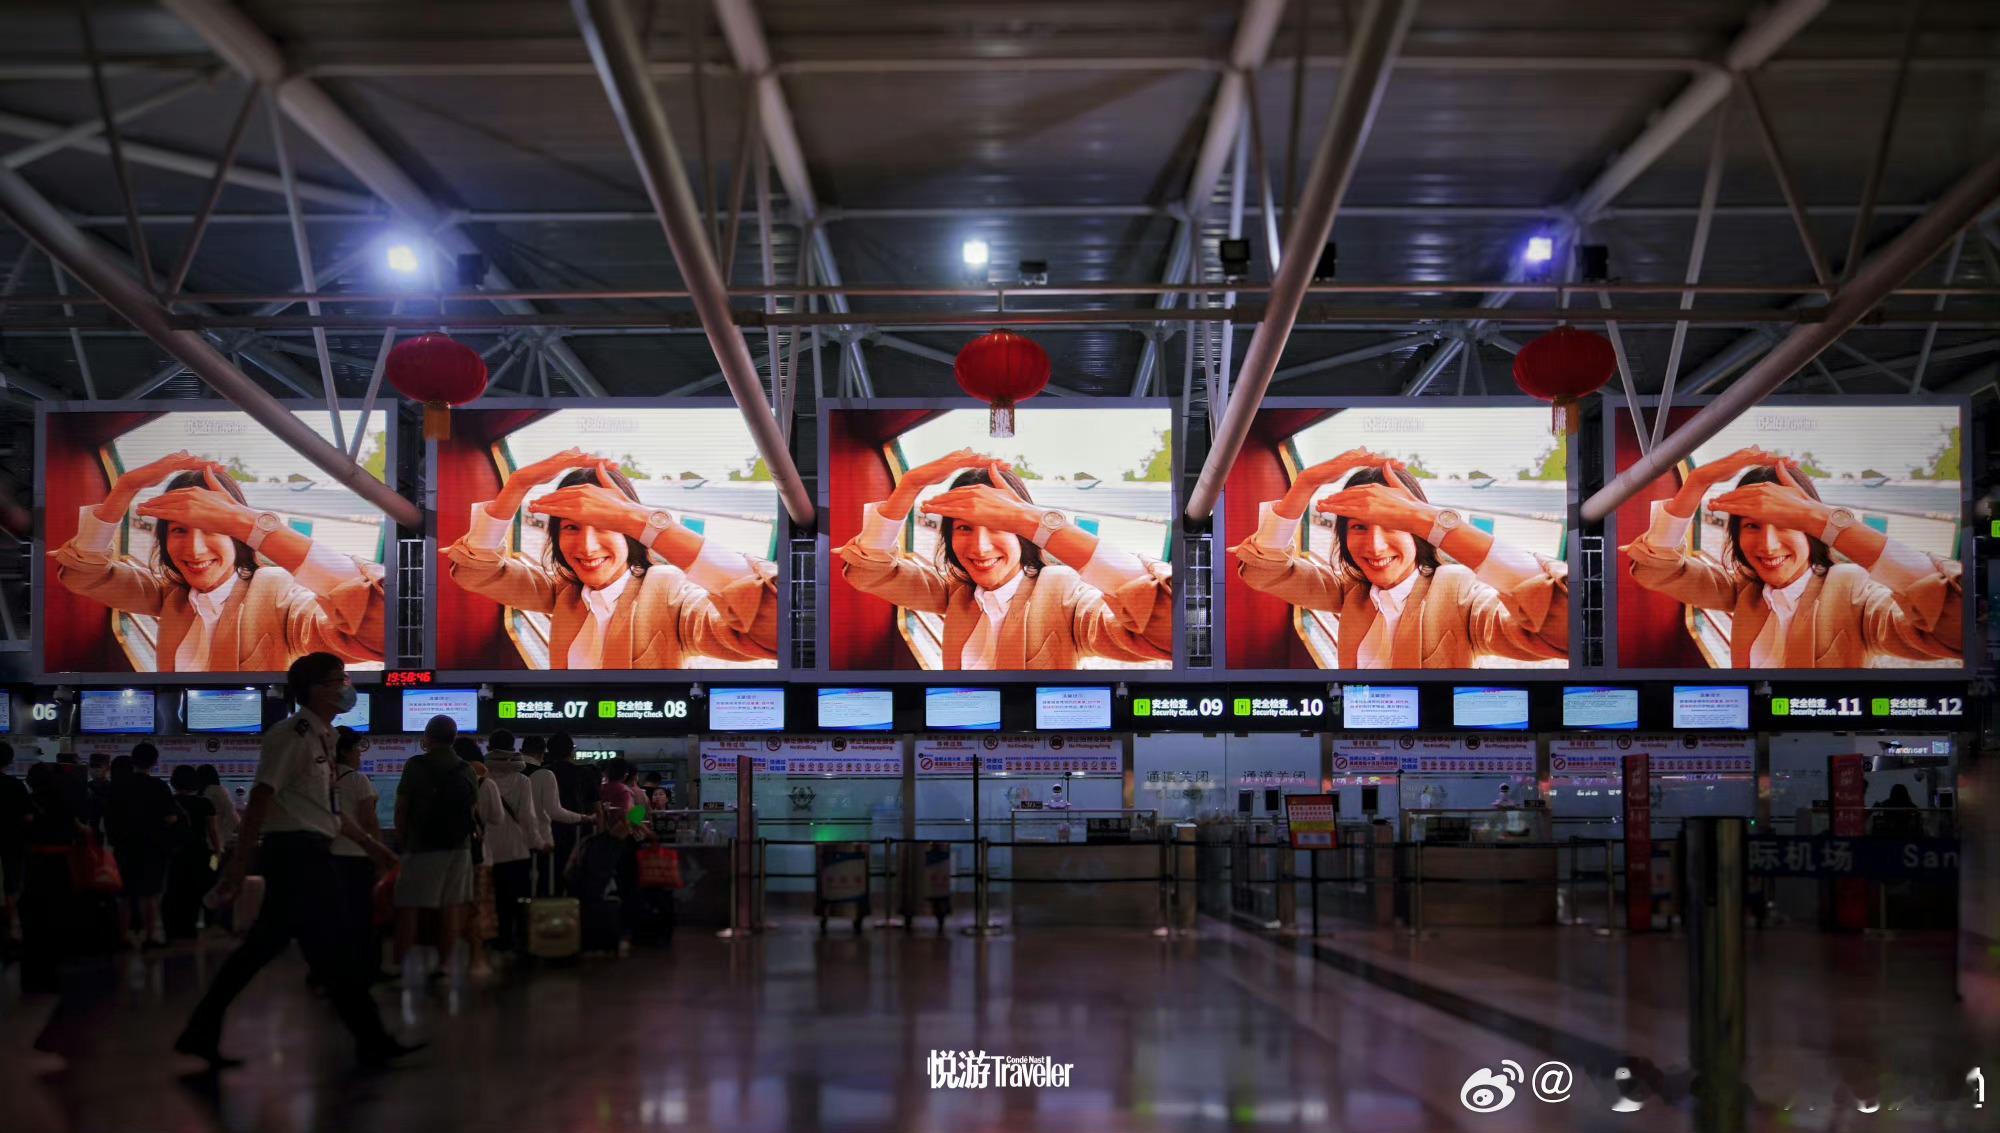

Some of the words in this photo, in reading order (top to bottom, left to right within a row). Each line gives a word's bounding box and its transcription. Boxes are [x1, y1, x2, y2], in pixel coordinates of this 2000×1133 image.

[517, 701, 553, 711] 安全检查
[617, 700, 653, 710] 安全检查
[1152, 699, 1188, 709] 安全检查
[1200, 698, 1223, 716] 09
[1252, 699, 1288, 709] 安全检查
[1300, 699, 1324, 716] 10
[1790, 698, 1826, 708] 安全检查
[1838, 698, 1862, 715] 11
[1890, 698, 1926, 708] 安全检查
[1938, 698, 1963, 715] 12
[32, 703, 57, 720] 06
[564, 701, 588, 718] 07
[617, 710, 642, 718] Security
[664, 700, 688, 718] 08
[1152, 709, 1177, 717] Security
[1252, 709, 1277, 717] Security
[1790, 708, 1815, 716] Security
[1890, 708, 1915, 716] Security
[517, 711, 542, 719] Security
[1748, 841, 1854, 872] 际机场
[1903, 843, 1959, 868] San
